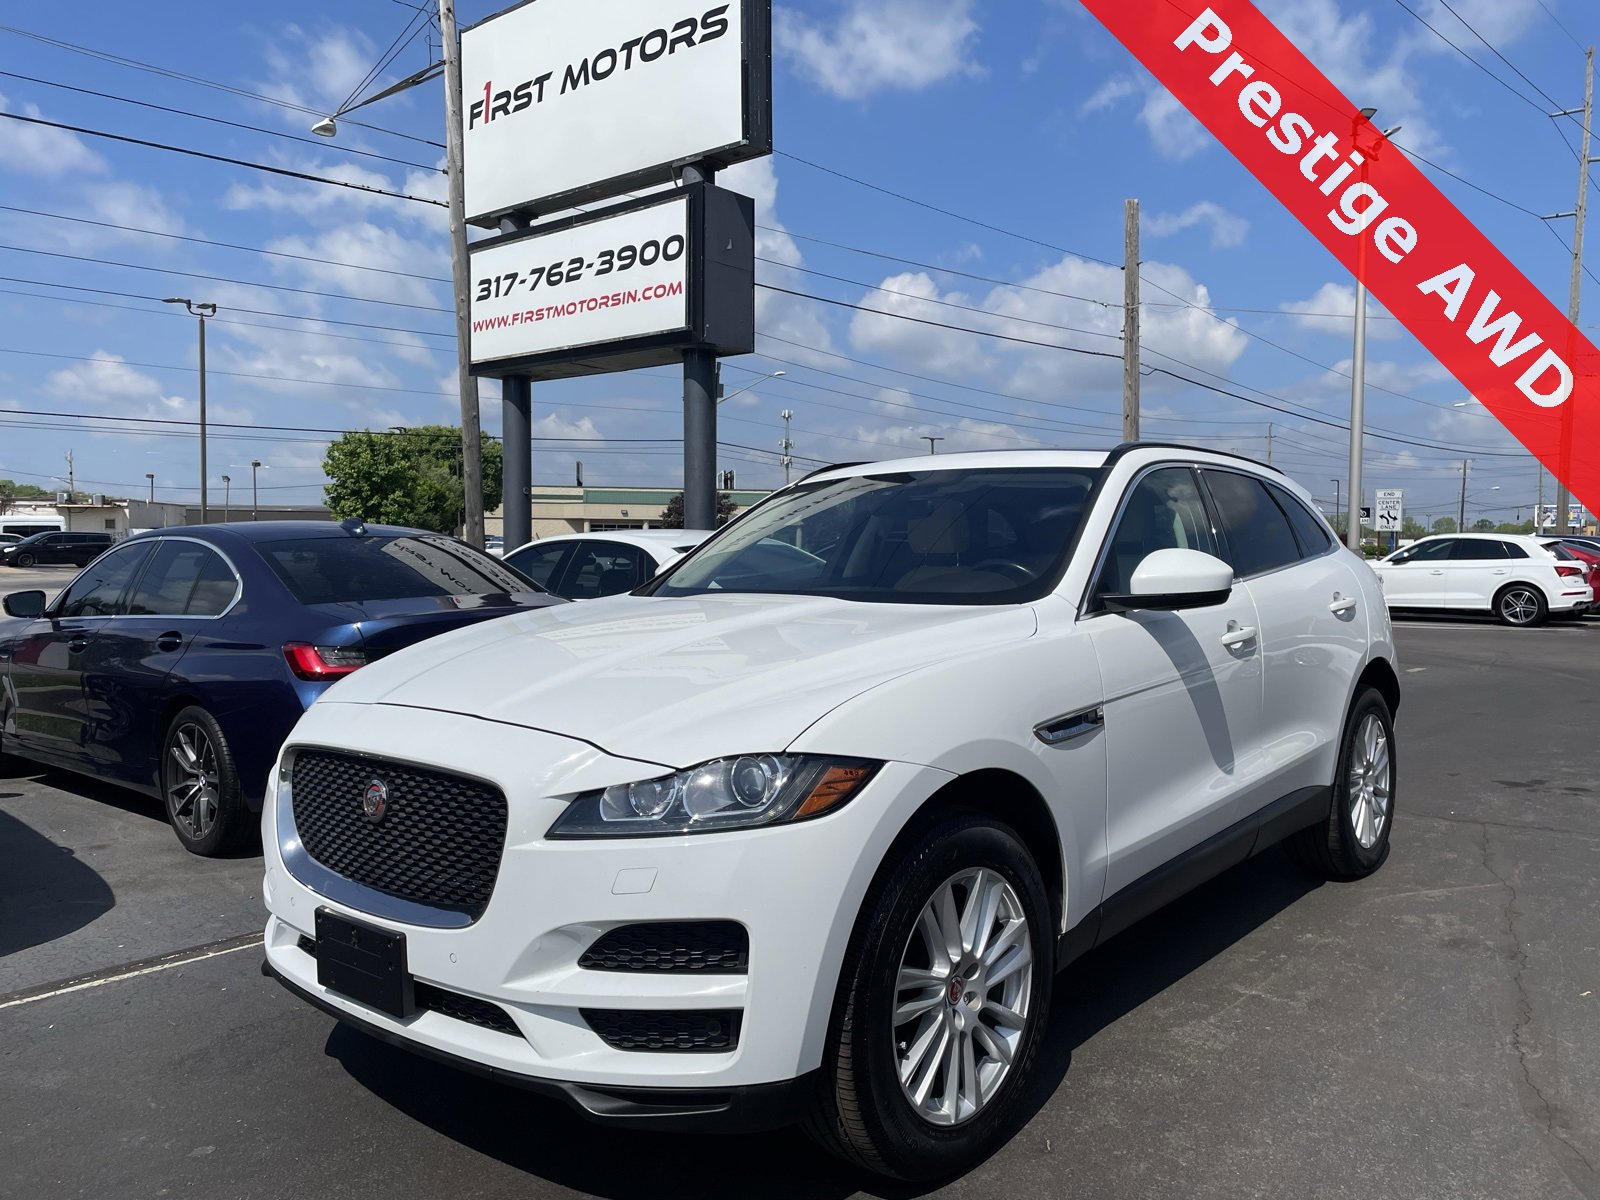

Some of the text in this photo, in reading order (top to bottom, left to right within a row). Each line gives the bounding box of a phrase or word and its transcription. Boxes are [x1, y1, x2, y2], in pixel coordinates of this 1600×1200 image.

[559, 3, 730, 96] MOTORS
[475, 234, 685, 302] 317-762-3900
[473, 281, 683, 333] WWW.FIRSTMOTORSIN.COM
